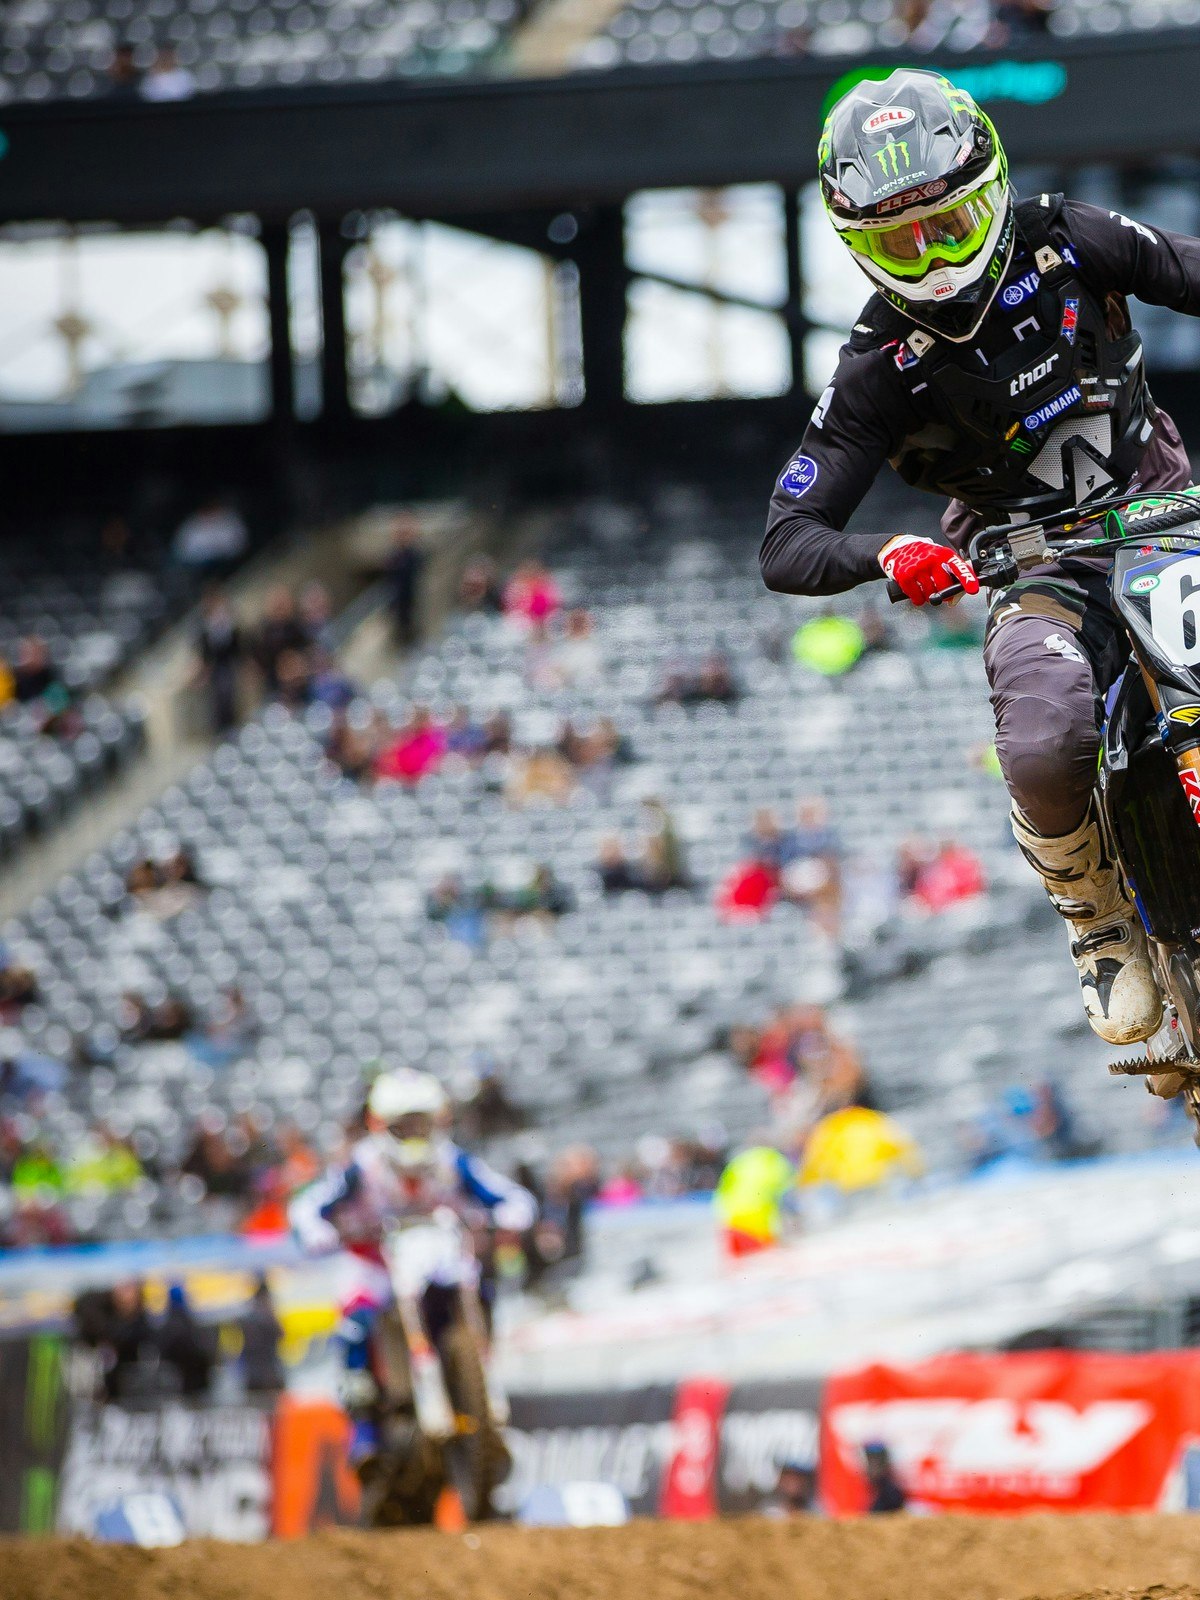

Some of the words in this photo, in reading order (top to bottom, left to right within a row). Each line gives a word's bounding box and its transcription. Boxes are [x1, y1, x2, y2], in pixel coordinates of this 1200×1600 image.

[870, 111, 907, 128] BELL
[873, 170, 928, 197] MONSTER
[935, 284, 954, 296] BELL
[1010, 353, 1060, 397] thor
[1036, 387, 1082, 422] YAMAHA
[948, 554, 976, 584] THOR
